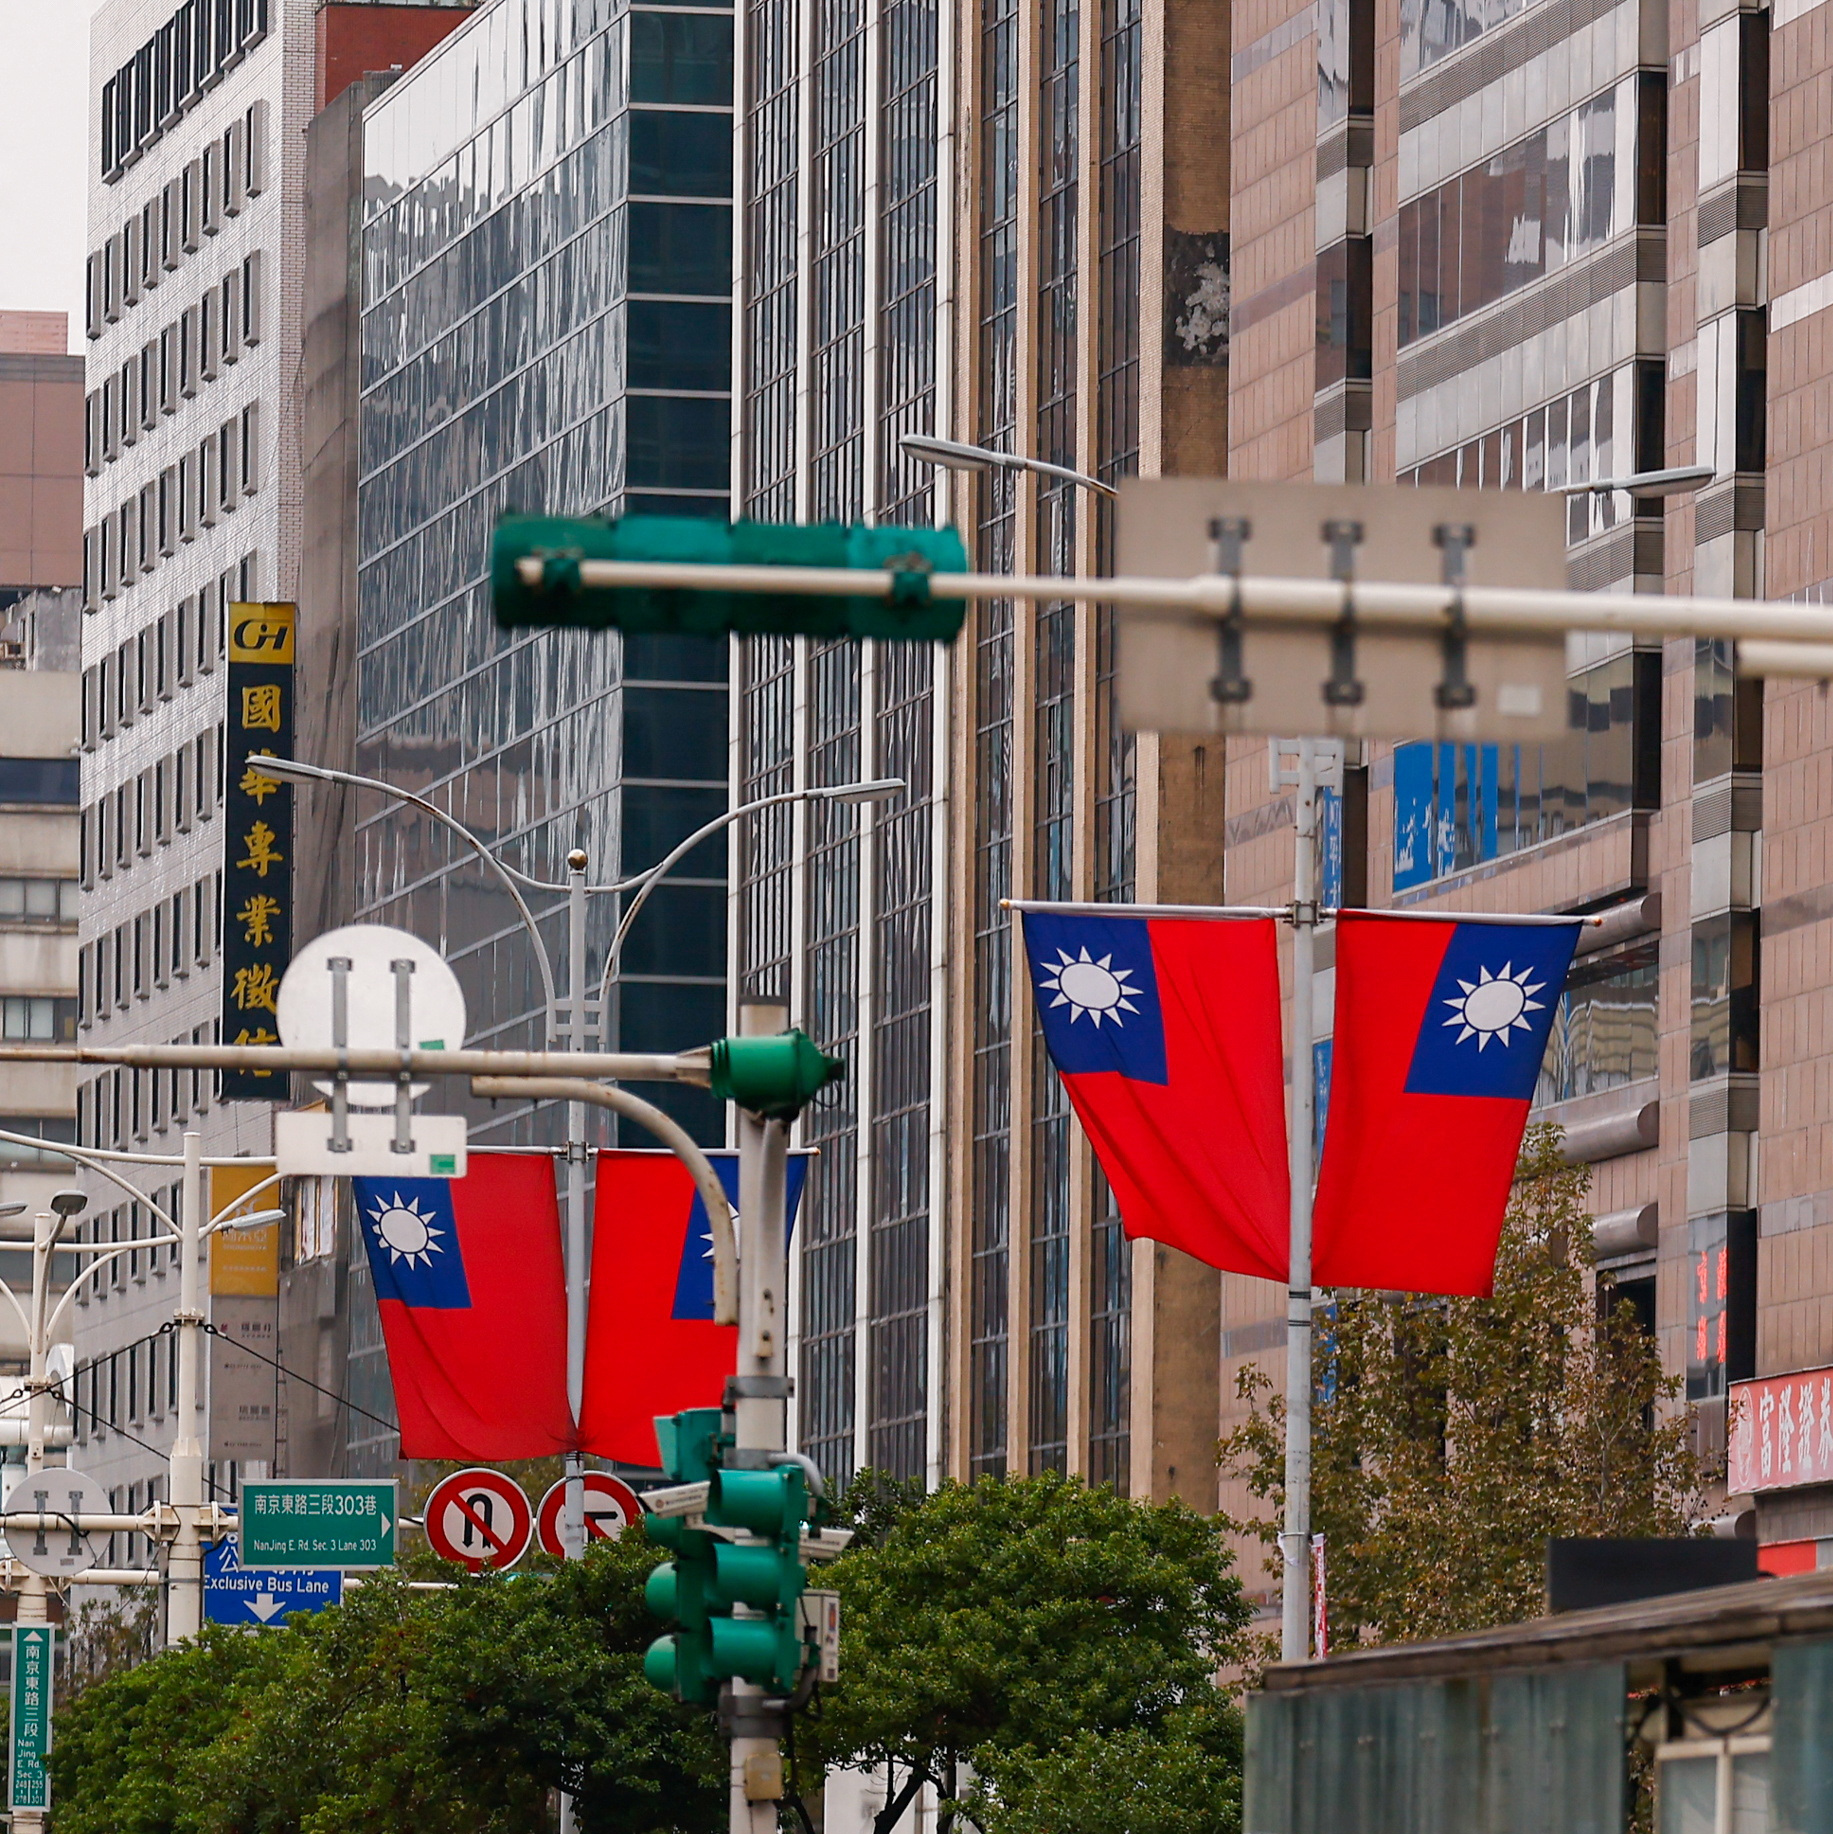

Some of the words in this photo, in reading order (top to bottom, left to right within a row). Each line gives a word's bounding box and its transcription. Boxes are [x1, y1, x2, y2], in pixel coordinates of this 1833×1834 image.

[254, 1493, 377, 1516] 南京東路三段303巷
[331, 1540, 336, 1551] 3
[338, 1540, 358, 1551] Lane
[359, 1539, 377, 1551] 303
[204, 1575, 263, 1591] Exclusive
[268, 1577, 293, 1592] Bus
[297, 1579, 329, 1593] Lane
[24, 1645, 40, 1737] 南京東路三段
[18, 1739, 35, 1748] Nan
[18, 1751, 36, 1762] Jing
[37, 1770, 43, 1779] 3
